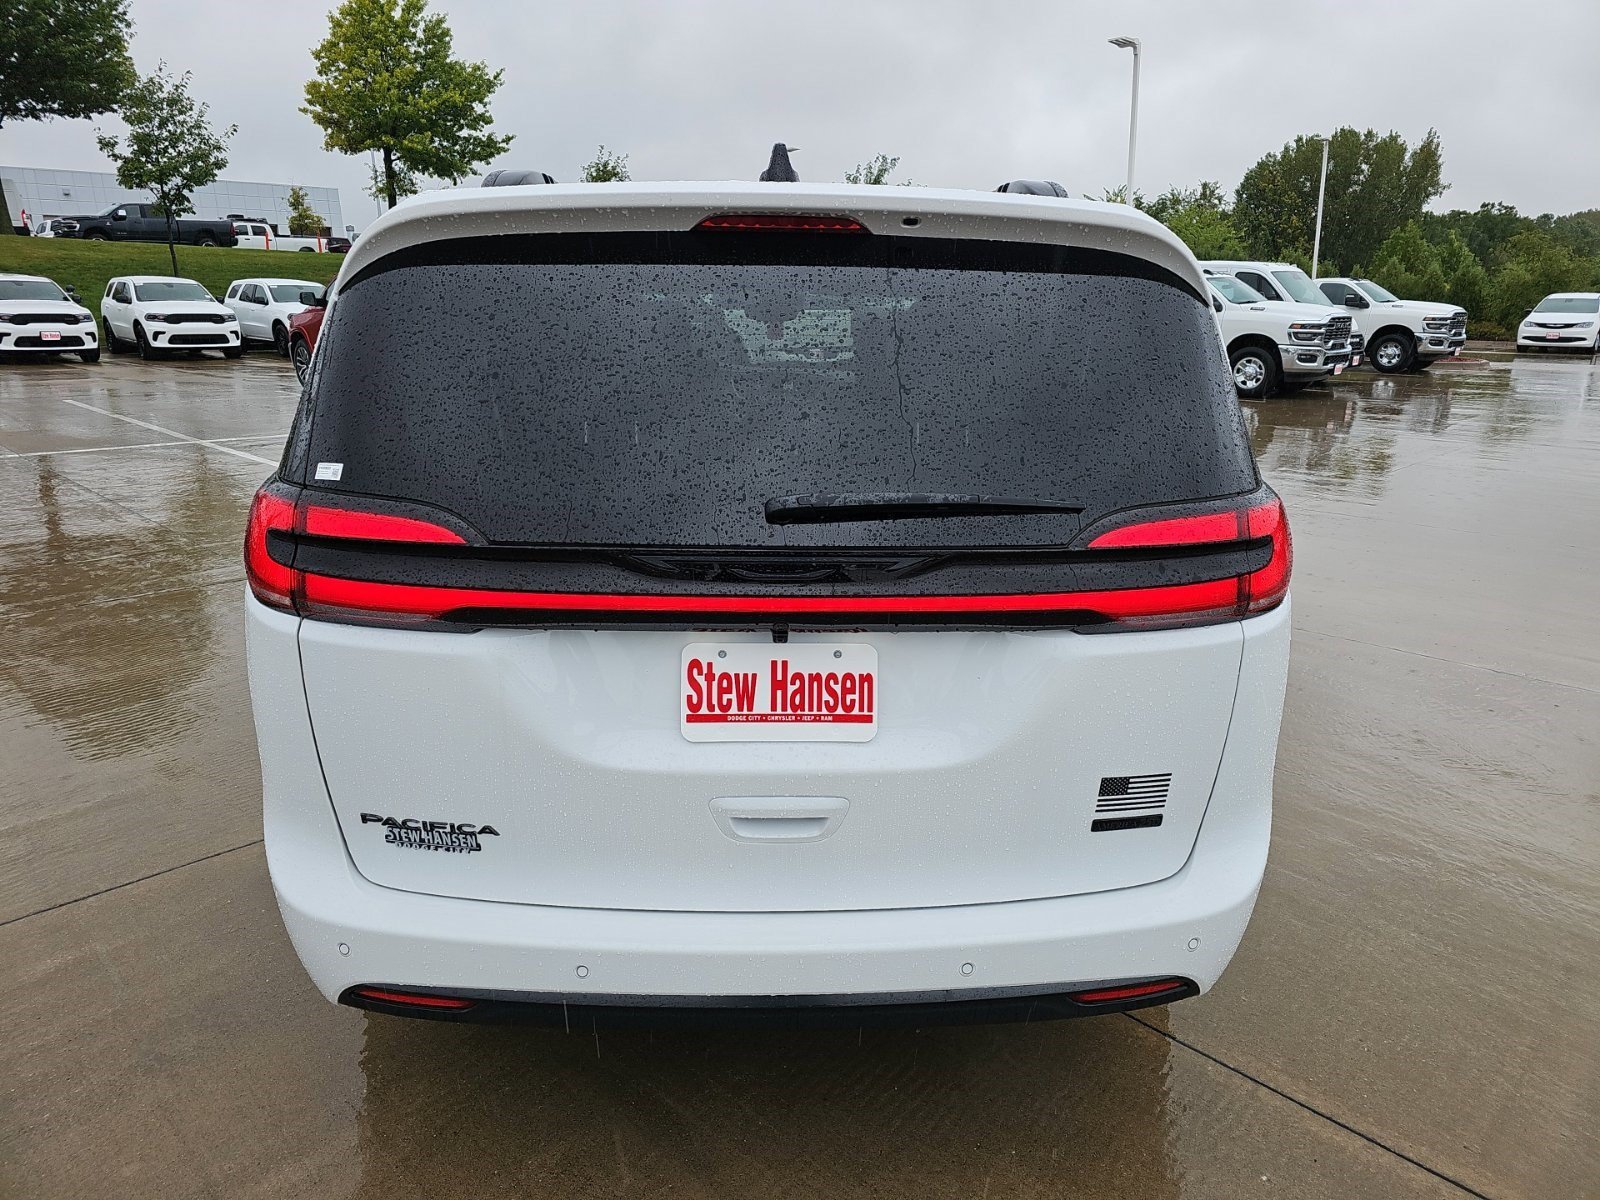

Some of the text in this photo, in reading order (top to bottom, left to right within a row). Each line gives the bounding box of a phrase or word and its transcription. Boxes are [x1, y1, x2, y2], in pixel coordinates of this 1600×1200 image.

[686, 658, 874, 713] Stew Hansen
[360, 812, 500, 836] PACIFICA
[385, 826, 478, 849] STEW HANSEN
